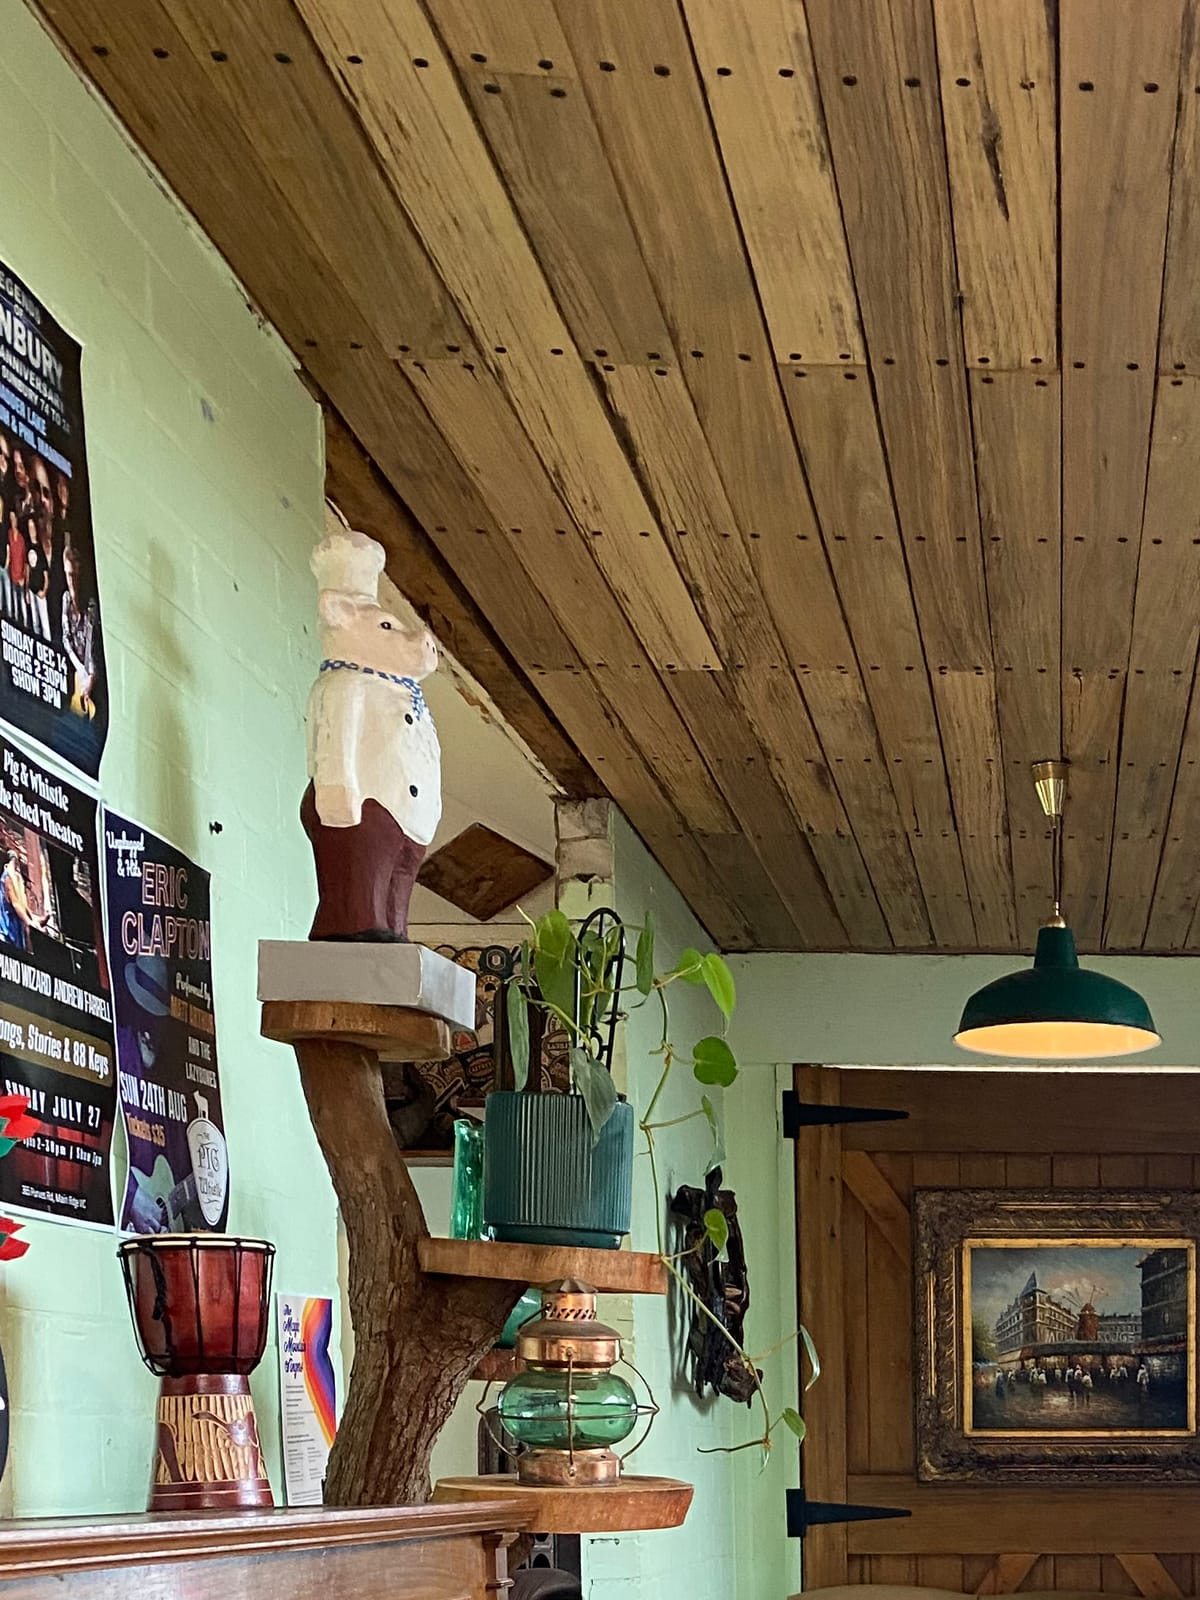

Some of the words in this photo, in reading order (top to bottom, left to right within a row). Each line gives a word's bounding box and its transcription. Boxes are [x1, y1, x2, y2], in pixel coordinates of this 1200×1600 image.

[0, 303, 63, 392] NBURY
[1, 619, 34, 656] SUNDAY
[36, 641, 55, 668] DEC
[57, 653, 68, 675] 14
[3, 640, 33, 674] DOORS
[33, 659, 68, 695] 2.30PM
[11, 666, 40, 697] SHOW
[41, 682, 61, 709] 3PM
[4, 748, 20, 786] Pig
[20, 762, 29, 787] &
[29, 769, 69, 812] Whistle
[12, 791, 40, 827] Shed
[40, 808, 84, 852] Theatre
[117, 858, 125, 878] &
[142, 861, 188, 909] ERIC
[121, 911, 210, 961] CLAPTON
[0, 953, 20, 985] IANO
[21, 962, 52, 998] WIZARD
[53, 977, 84, 1011] ANDREW
[84, 990, 112, 1023] FARRELL
[28, 1023, 62, 1060] Stories
[64, 1037, 72, 1062] &
[73, 1041, 86, 1068] 88
[88, 1045, 109, 1080] Keys
[52, 1095, 82, 1123] JULY
[87, 1103, 101, 1129] 27
[120, 1071, 140, 1107] SUN
[140, 1079, 166, 1116] 24TH
[168, 1089, 188, 1123] AUG
[197, 1145, 220, 1173] PIG
